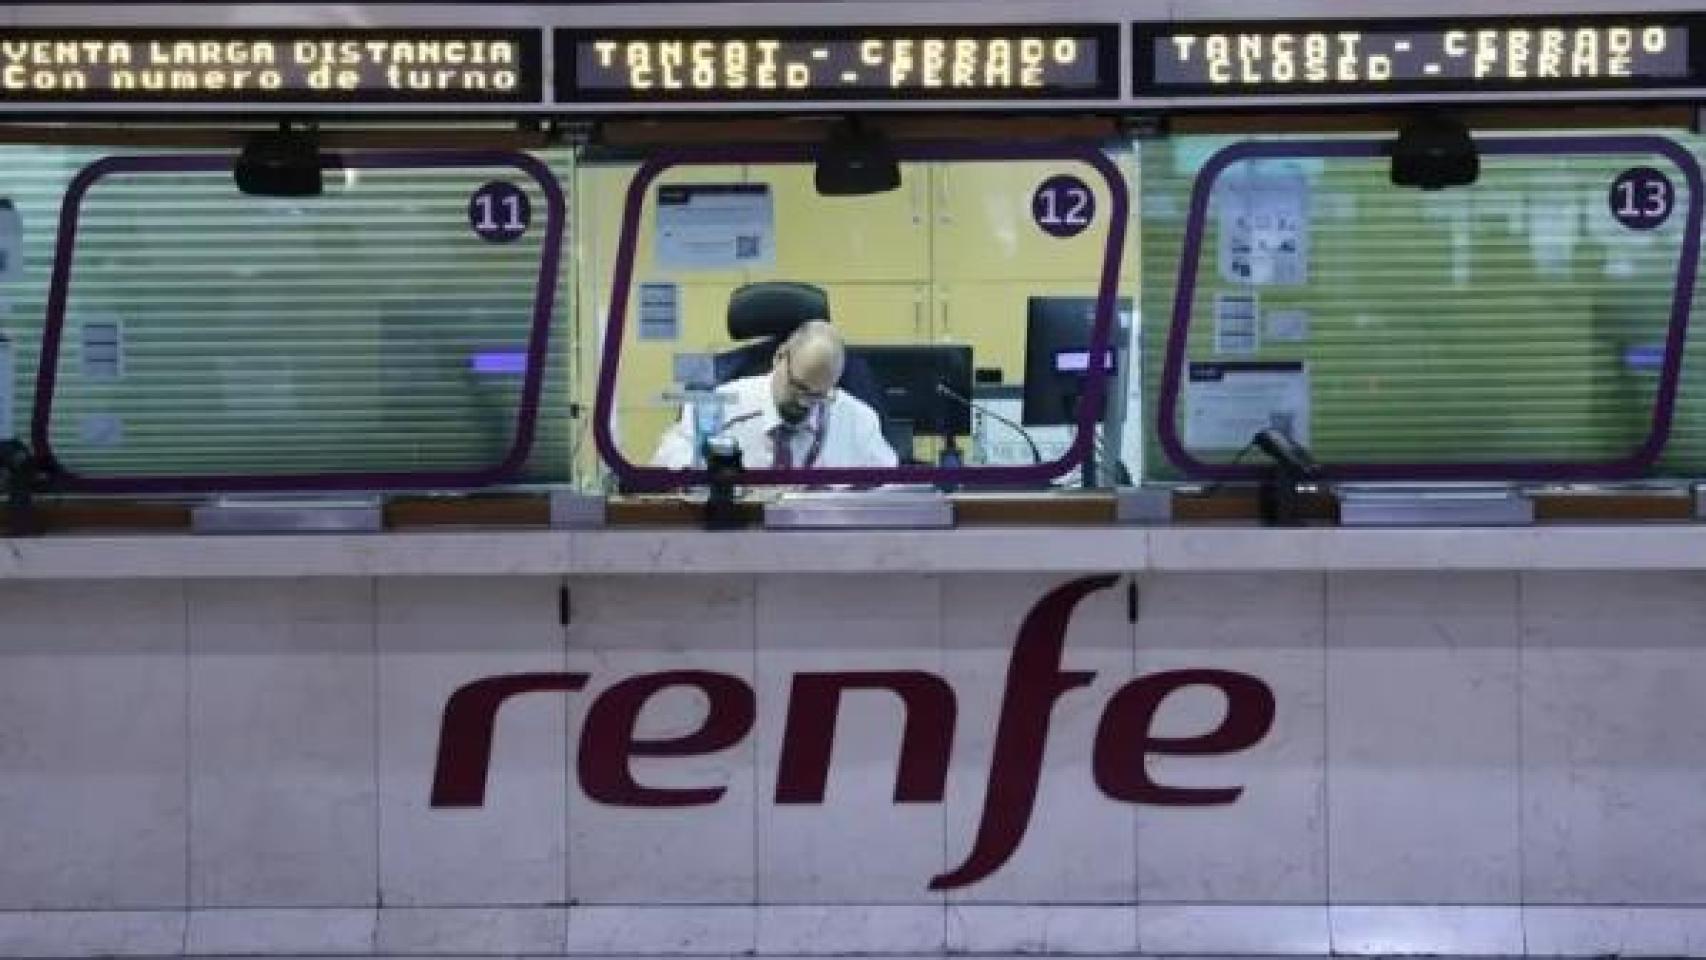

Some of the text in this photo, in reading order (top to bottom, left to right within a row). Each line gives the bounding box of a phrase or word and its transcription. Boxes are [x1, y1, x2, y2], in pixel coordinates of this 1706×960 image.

[150, 40, 275, 63] LARGA
[294, 40, 513, 63] DISTANCIA
[2, 65, 516, 89] Con numero de turno
[630, 63, 809, 89] CLOSED
[1208, 55, 1392, 83] CLOSED
[476, 195, 525, 230] 11
[1039, 189, 1088, 224] 12
[1617, 180, 1668, 217] 13
[430, 574, 1276, 890] renfe
